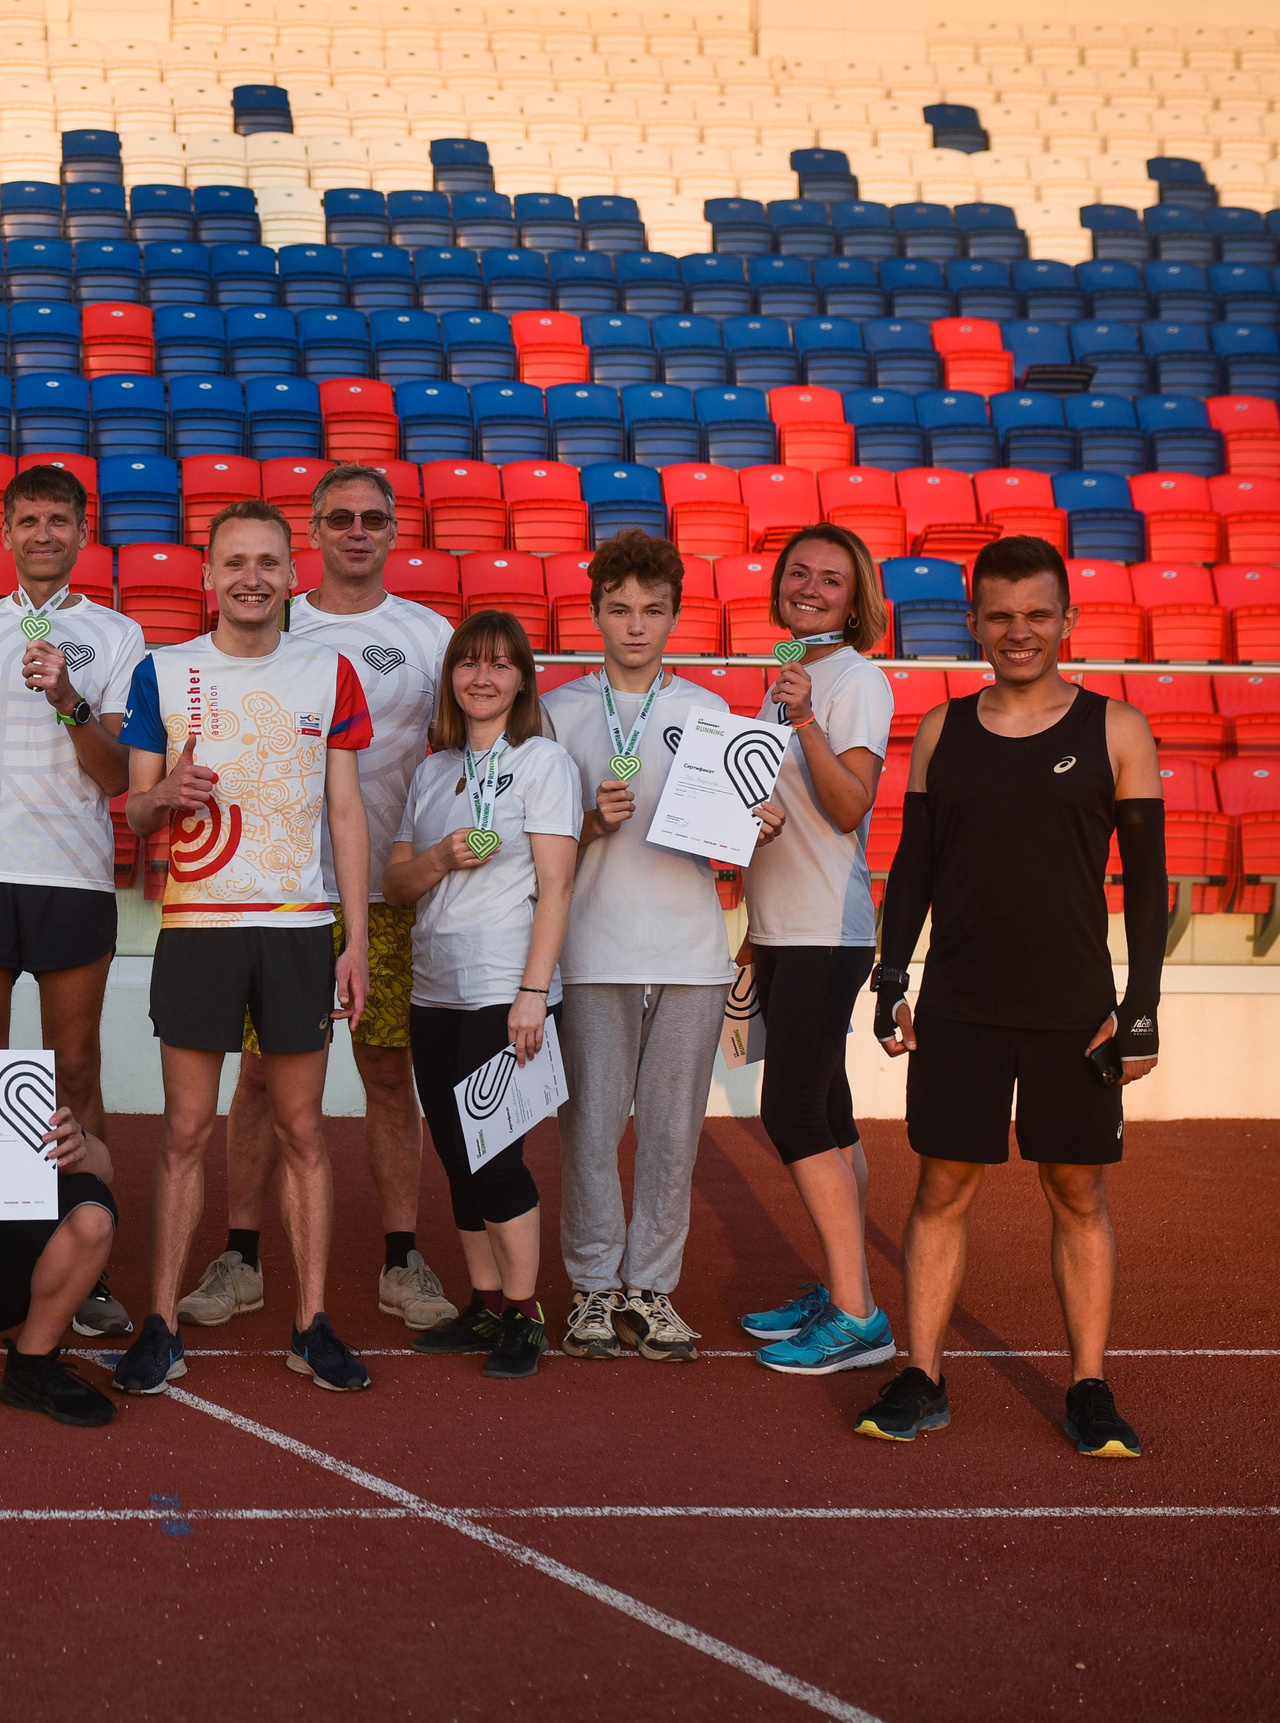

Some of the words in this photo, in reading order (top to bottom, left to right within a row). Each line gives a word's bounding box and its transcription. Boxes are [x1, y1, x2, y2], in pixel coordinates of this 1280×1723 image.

[187, 667, 202, 737] finisher
[209, 685, 219, 736] aquathlon
[605, 692, 616, 717] RUNNING
[644, 689, 656, 714] RUNNING
[626, 729, 640, 753] RUNNING
[695, 725, 725, 737] RUNNING
[487, 751, 499, 780] RUNNING
[683, 762, 715, 774] Сертификат
[481, 802, 491, 828] RUNNING
[733, 1028, 746, 1056] RUNNING
